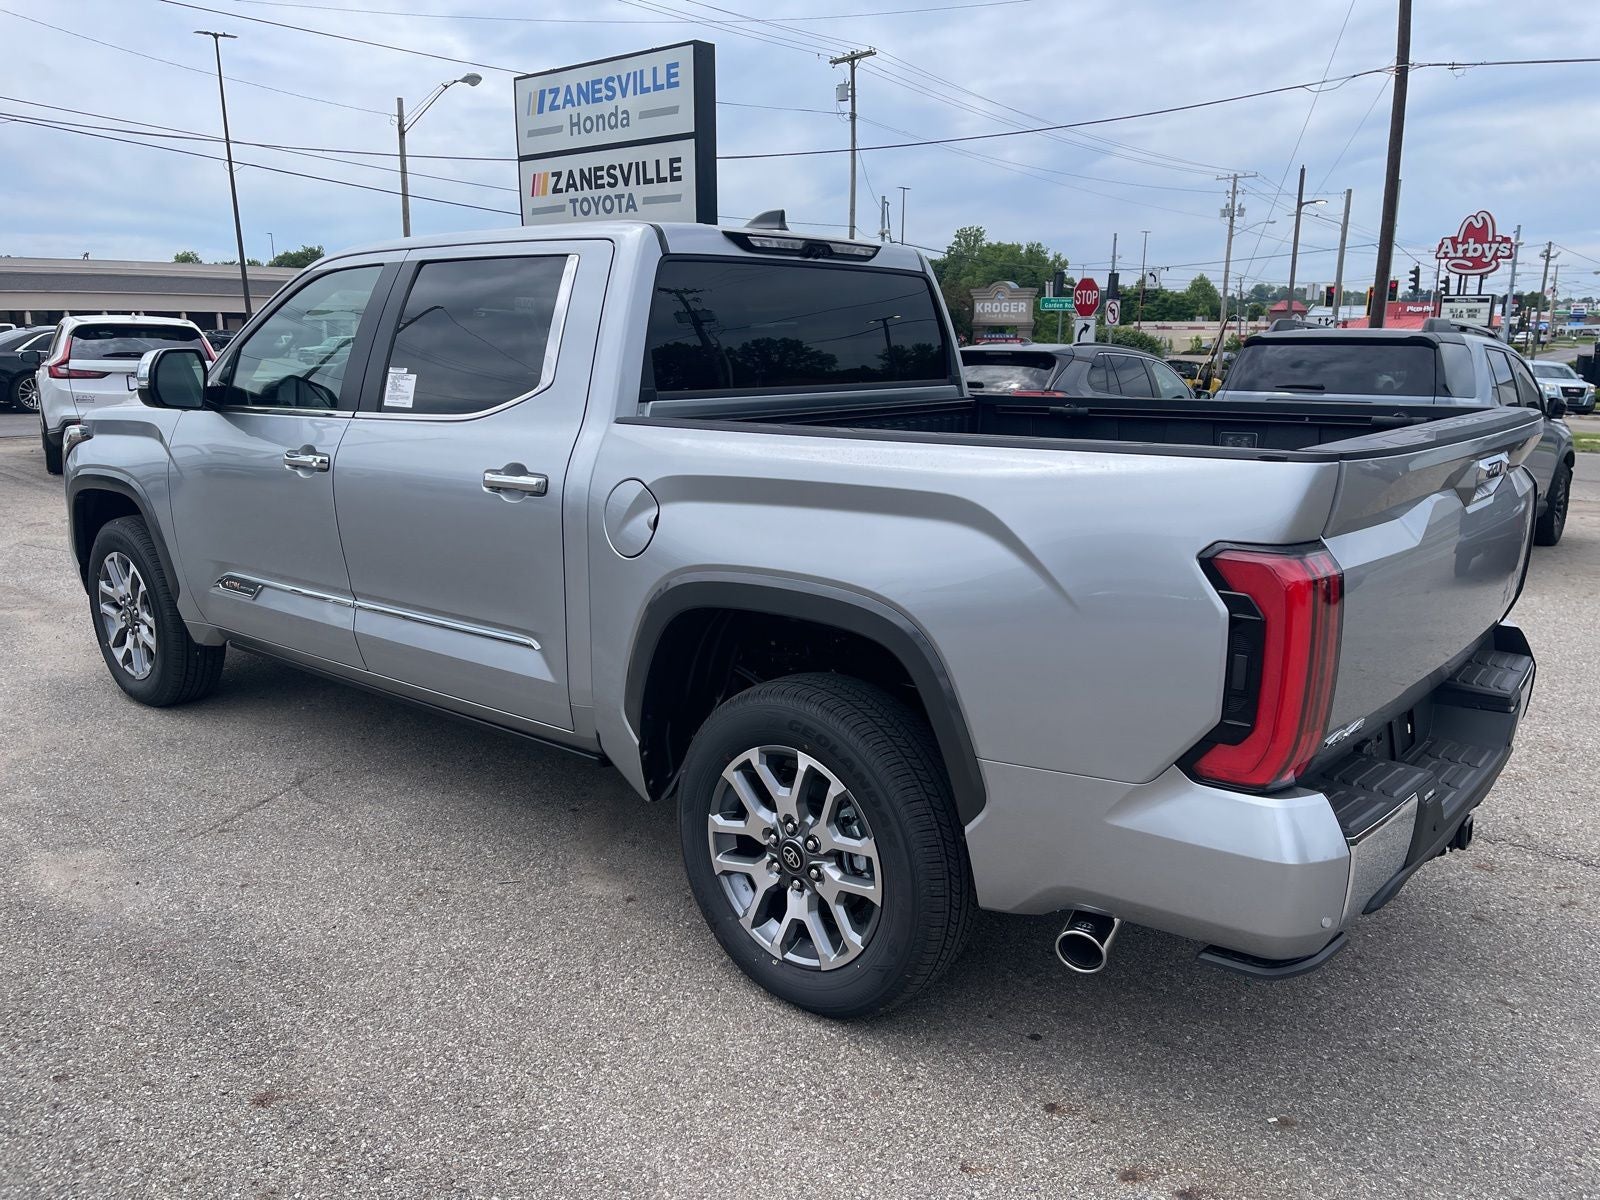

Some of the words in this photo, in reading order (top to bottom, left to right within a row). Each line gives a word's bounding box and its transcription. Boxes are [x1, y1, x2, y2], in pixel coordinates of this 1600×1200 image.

[548, 61, 680, 112] ZANESVILLE
[569, 105, 630, 136] Honda
[551, 156, 683, 195] ZANESVILLE
[569, 193, 638, 217] TOYOTA
[1437, 236, 1512, 262] Arby's
[976, 302, 1027, 313] KROGER
[1075, 290, 1098, 305] STOP
